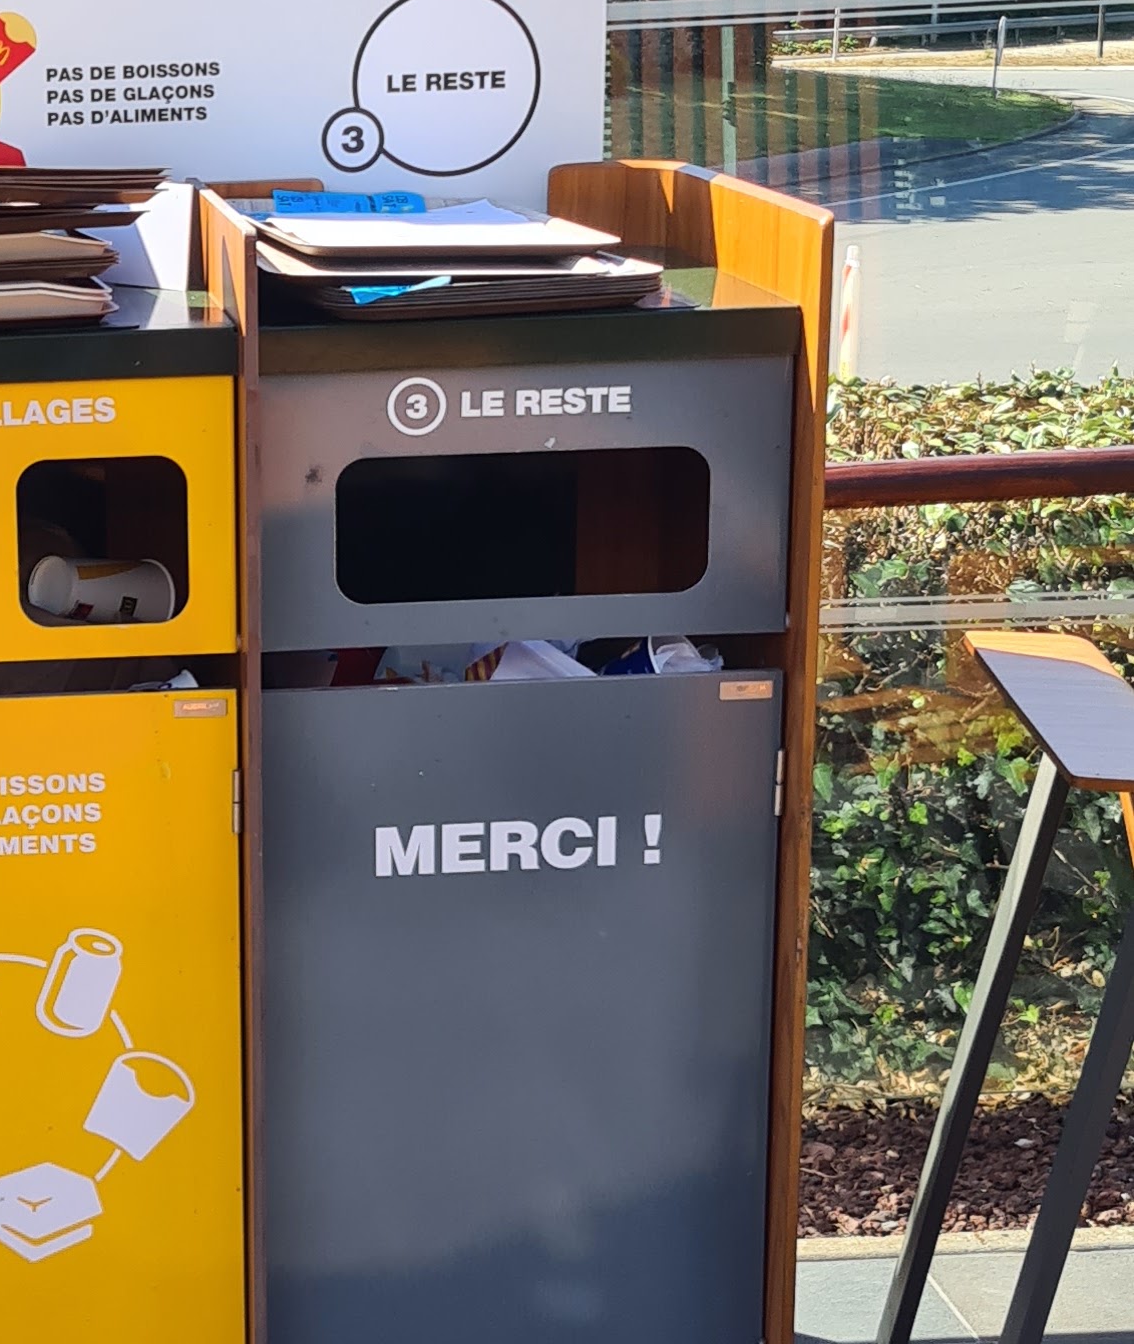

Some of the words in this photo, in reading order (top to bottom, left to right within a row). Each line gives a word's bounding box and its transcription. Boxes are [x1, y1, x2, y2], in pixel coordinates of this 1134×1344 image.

[47, 67, 83, 82] PAS
[90, 65, 115, 80] DE
[123, 62, 219, 79] BOISSONS
[387, 73, 416, 92] LE
[426, 70, 505, 91] RESTE
[47, 89, 83, 104] PAS
[91, 88, 115, 102] DE
[123, 85, 214, 103] GLAÇONS
[47, 111, 84, 126] PAS
[341, 126, 364, 153] 3
[406, 394, 427, 419] 3
[461, 390, 504, 417] LE
[516, 386, 630, 415] RESTE
[376, 817, 616, 876] MERCI
